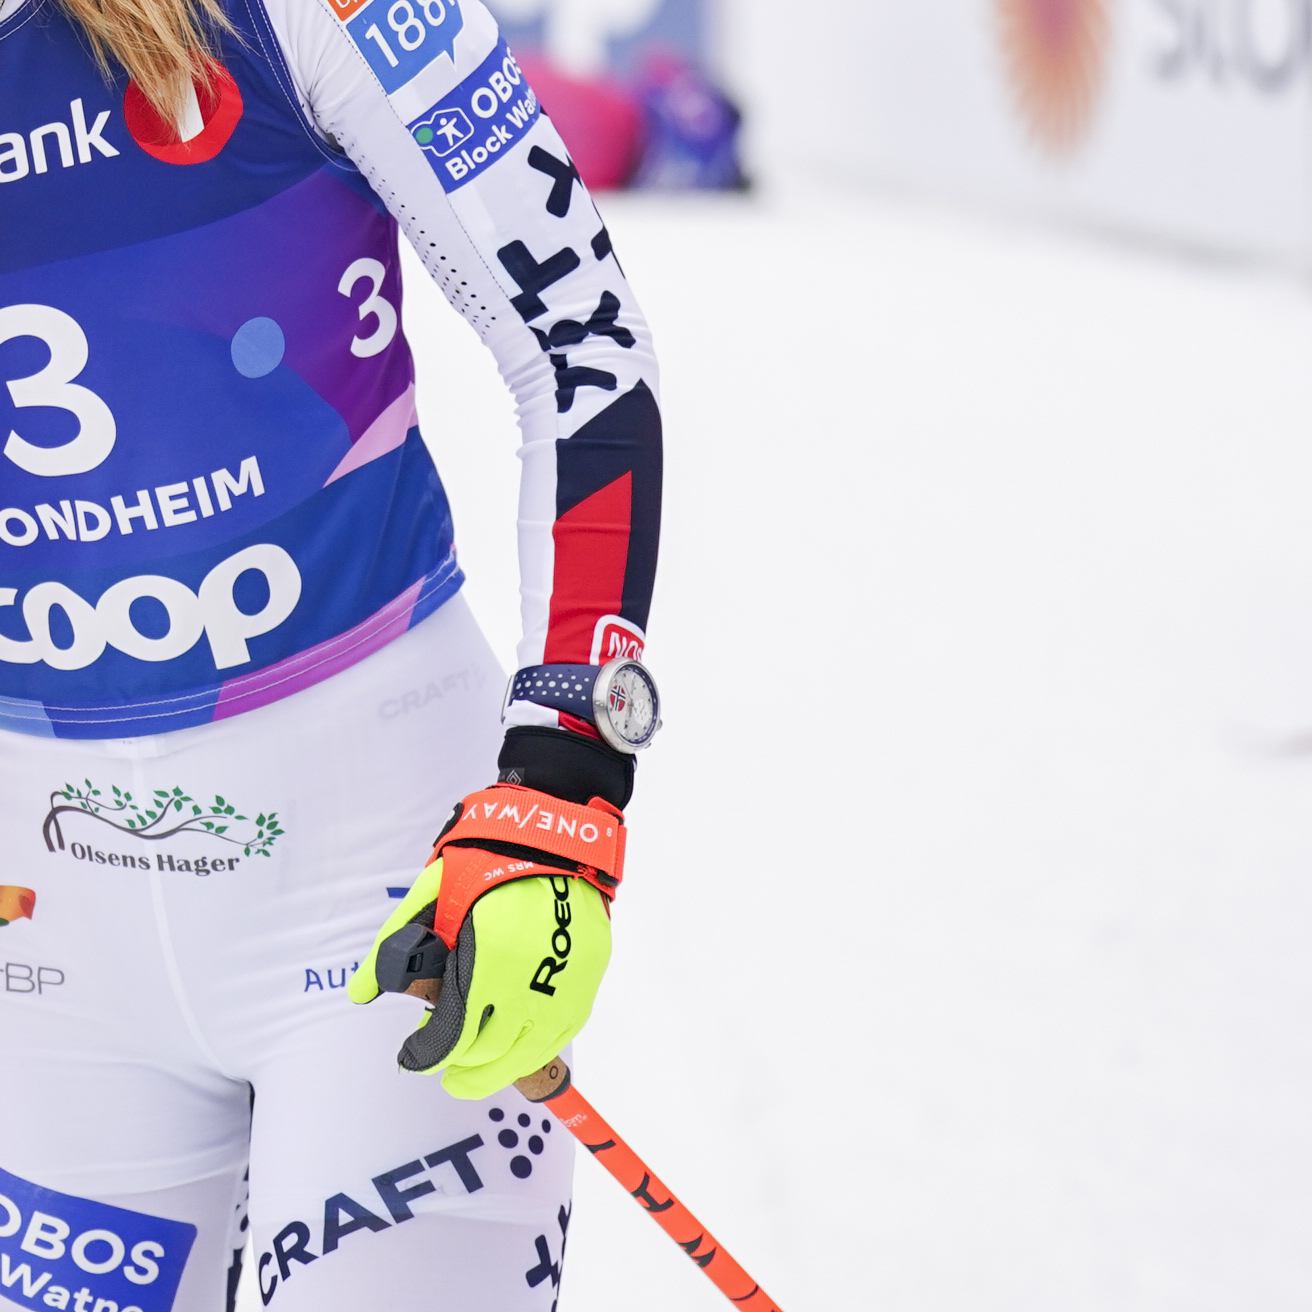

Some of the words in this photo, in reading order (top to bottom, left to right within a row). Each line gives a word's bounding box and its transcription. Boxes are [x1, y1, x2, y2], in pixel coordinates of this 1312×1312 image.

[444, 124, 514, 181] Block
[337, 257, 398, 358] 3
[70, 841, 150, 871] Olsens
[156, 853, 240, 876] Hager
[484, 867, 504, 881] WC
[507, 861, 534, 873] MRS
[258, 1133, 485, 1307] CRAFT
